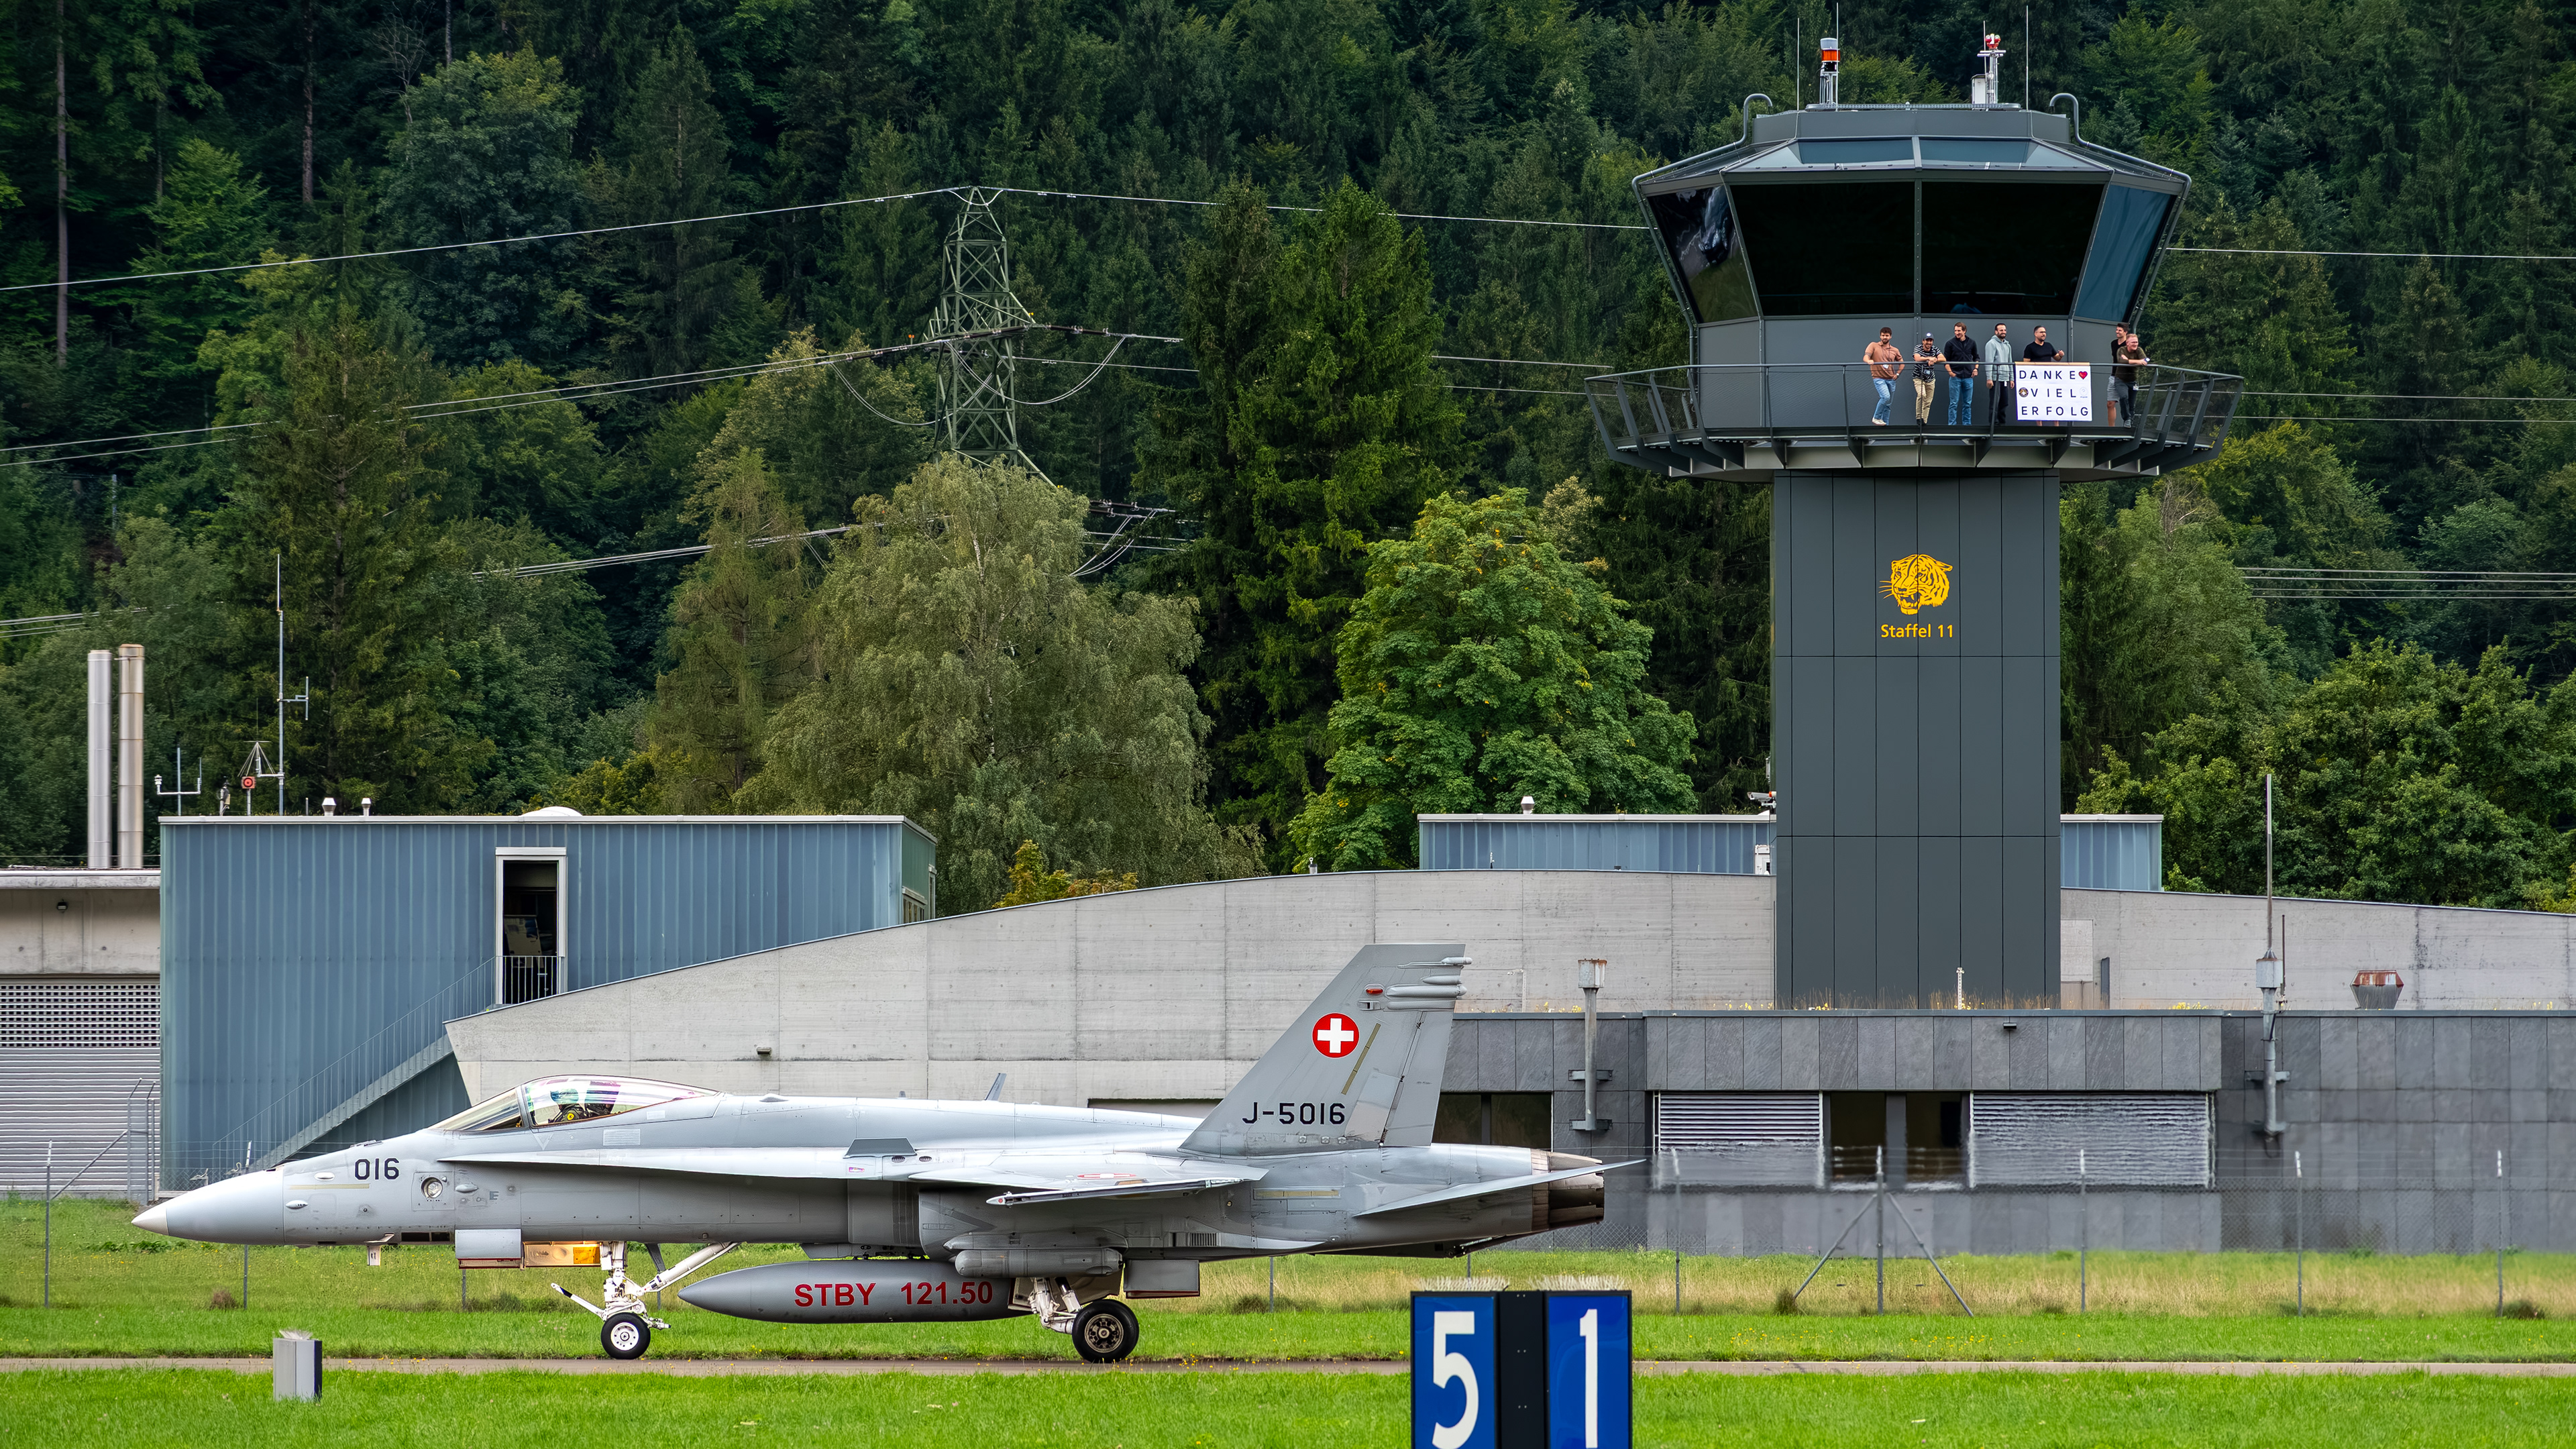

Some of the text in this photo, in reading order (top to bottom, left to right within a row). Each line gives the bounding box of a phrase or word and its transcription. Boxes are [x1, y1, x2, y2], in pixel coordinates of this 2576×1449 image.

[2019, 370, 2076, 380] DANKE
[2031, 388, 2076, 398] VIEL
[2021, 407, 2088, 416] ERFOLG
[1880, 623, 1953, 638] Staffel 11
[1242, 1102, 1346, 1125] J-5016
[354, 1158, 400, 1180] 016
[794, 1281, 993, 1307] STBY 121.50
[1432, 1311, 1479, 1449] 5
[1580, 1309, 1598, 1449] 1
